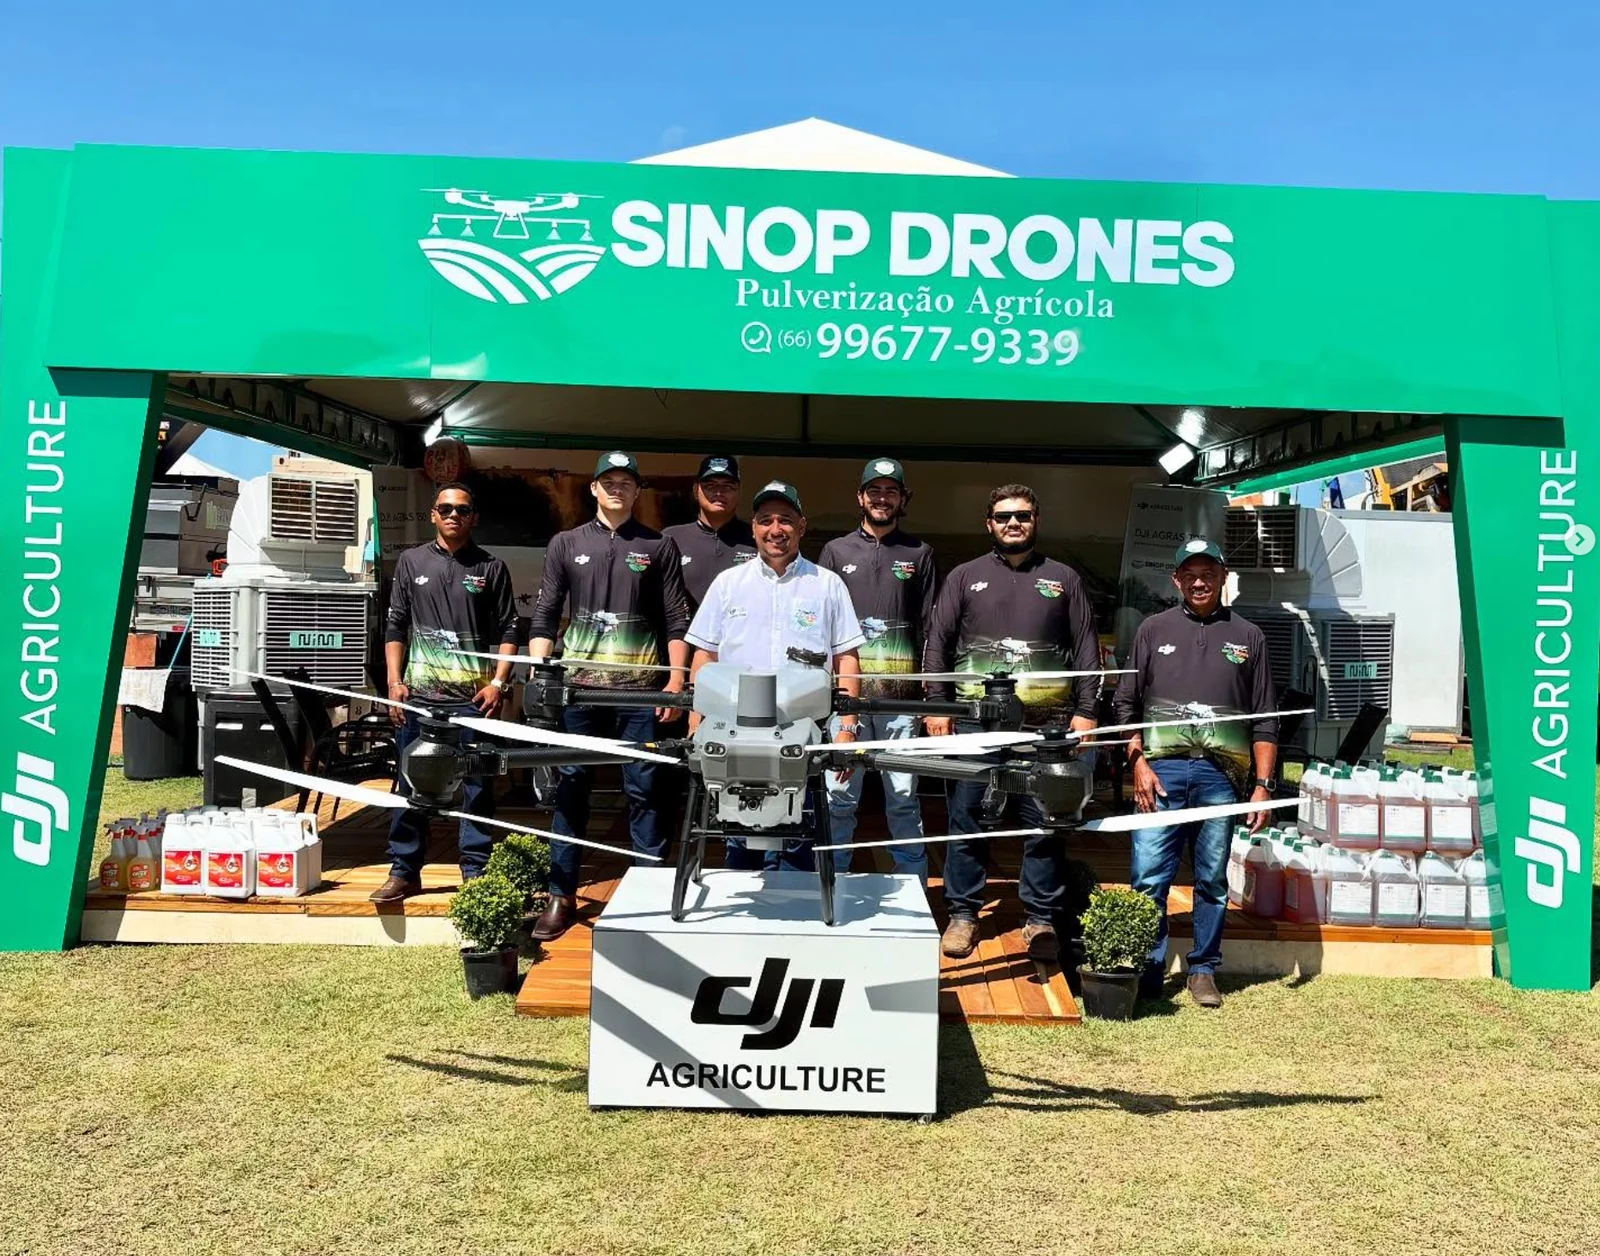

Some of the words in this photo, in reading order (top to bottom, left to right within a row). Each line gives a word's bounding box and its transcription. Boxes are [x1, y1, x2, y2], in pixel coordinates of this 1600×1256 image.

[611, 200, 871, 274] SINOP
[889, 211, 1235, 287] DRONES
[735, 278, 955, 318] Pulverização
[965, 285, 1115, 325] Agrícola
[777, 329, 812, 349] (66)
[816, 322, 1079, 366] 99677-9339
[1152, 530, 1185, 542] AGRAS
[20, 400, 66, 735] AGRICULTURE
[1532, 450, 1576, 747] AGRICULTURE
[646, 1061, 886, 1093] AGRICULTURE
